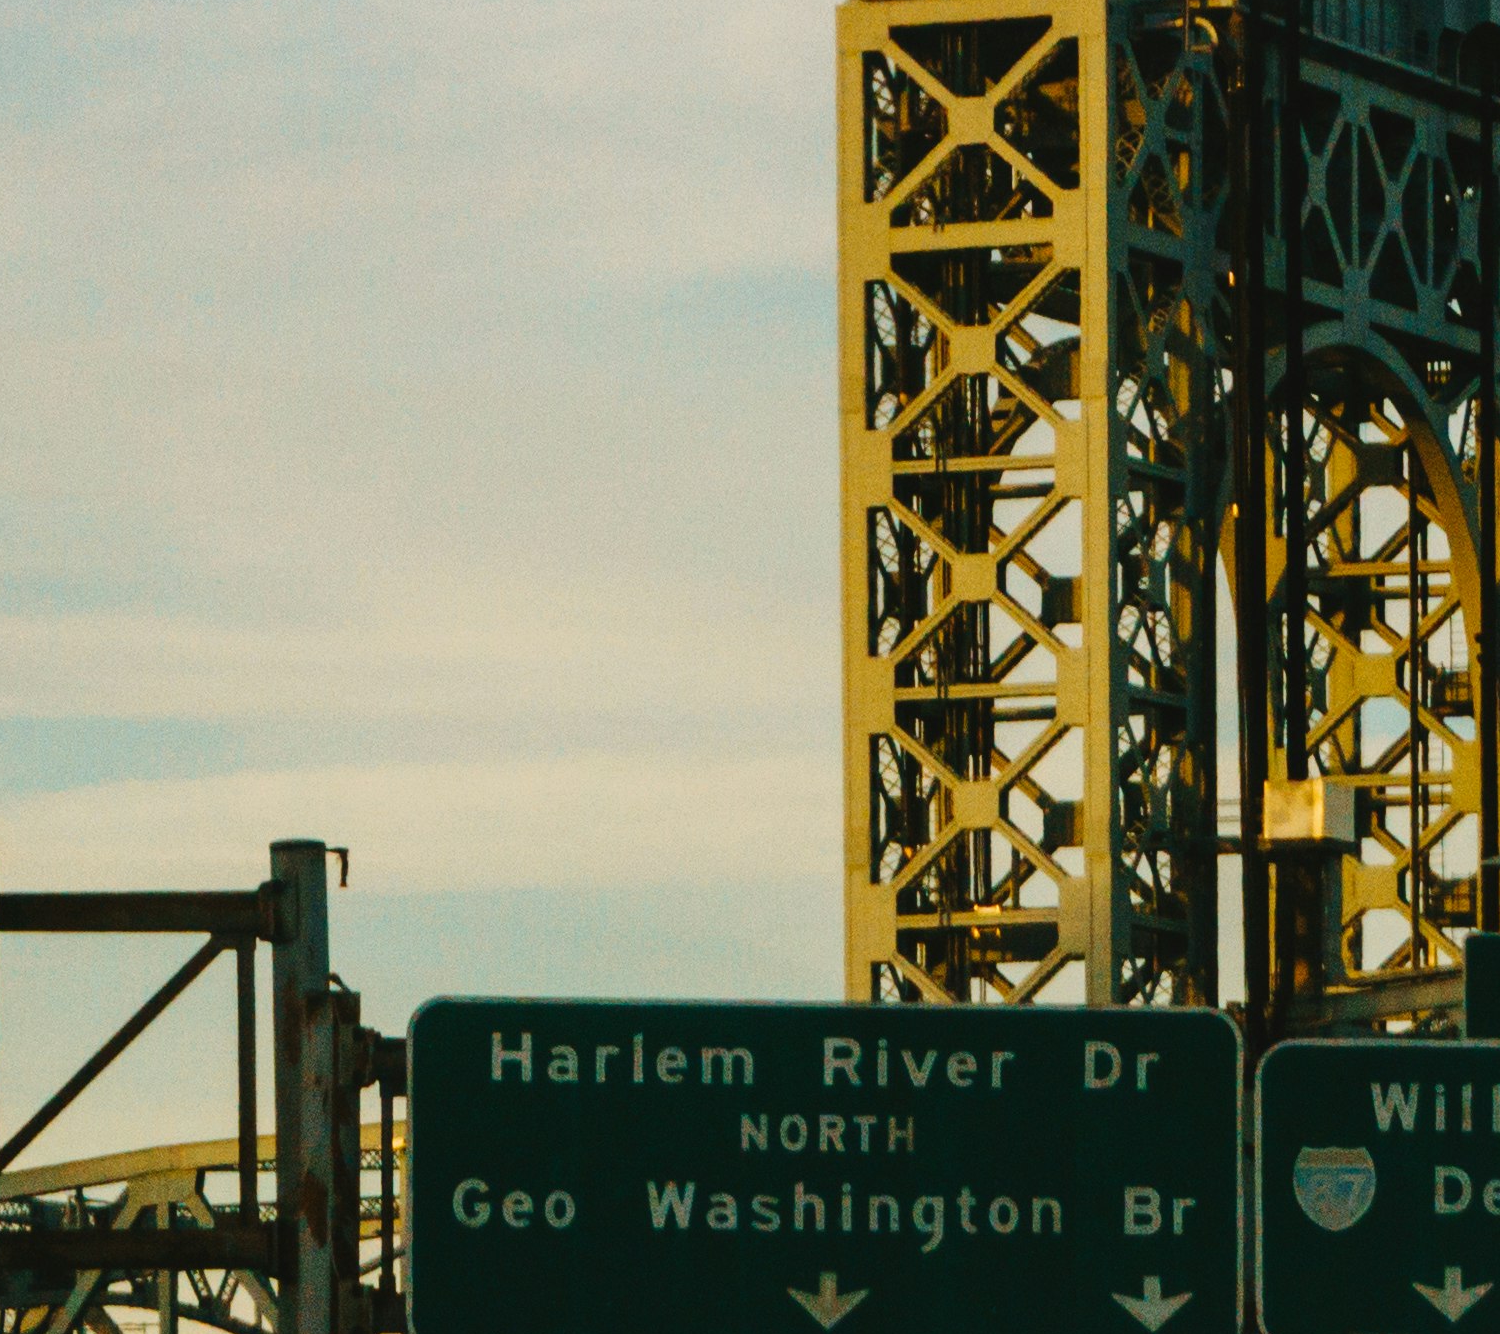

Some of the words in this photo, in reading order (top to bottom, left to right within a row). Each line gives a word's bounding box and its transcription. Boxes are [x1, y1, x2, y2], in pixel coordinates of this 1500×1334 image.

[491, 1031, 754, 1085] Harlem
[823, 1036, 1015, 1088] River
[1084, 1040, 1160, 1090] Dr
[740, 1114, 914, 1152] NORTH
[452, 1178, 576, 1229] Geo
[647, 1181, 1062, 1253] Washington
[1123, 1186, 1196, 1236] Br
